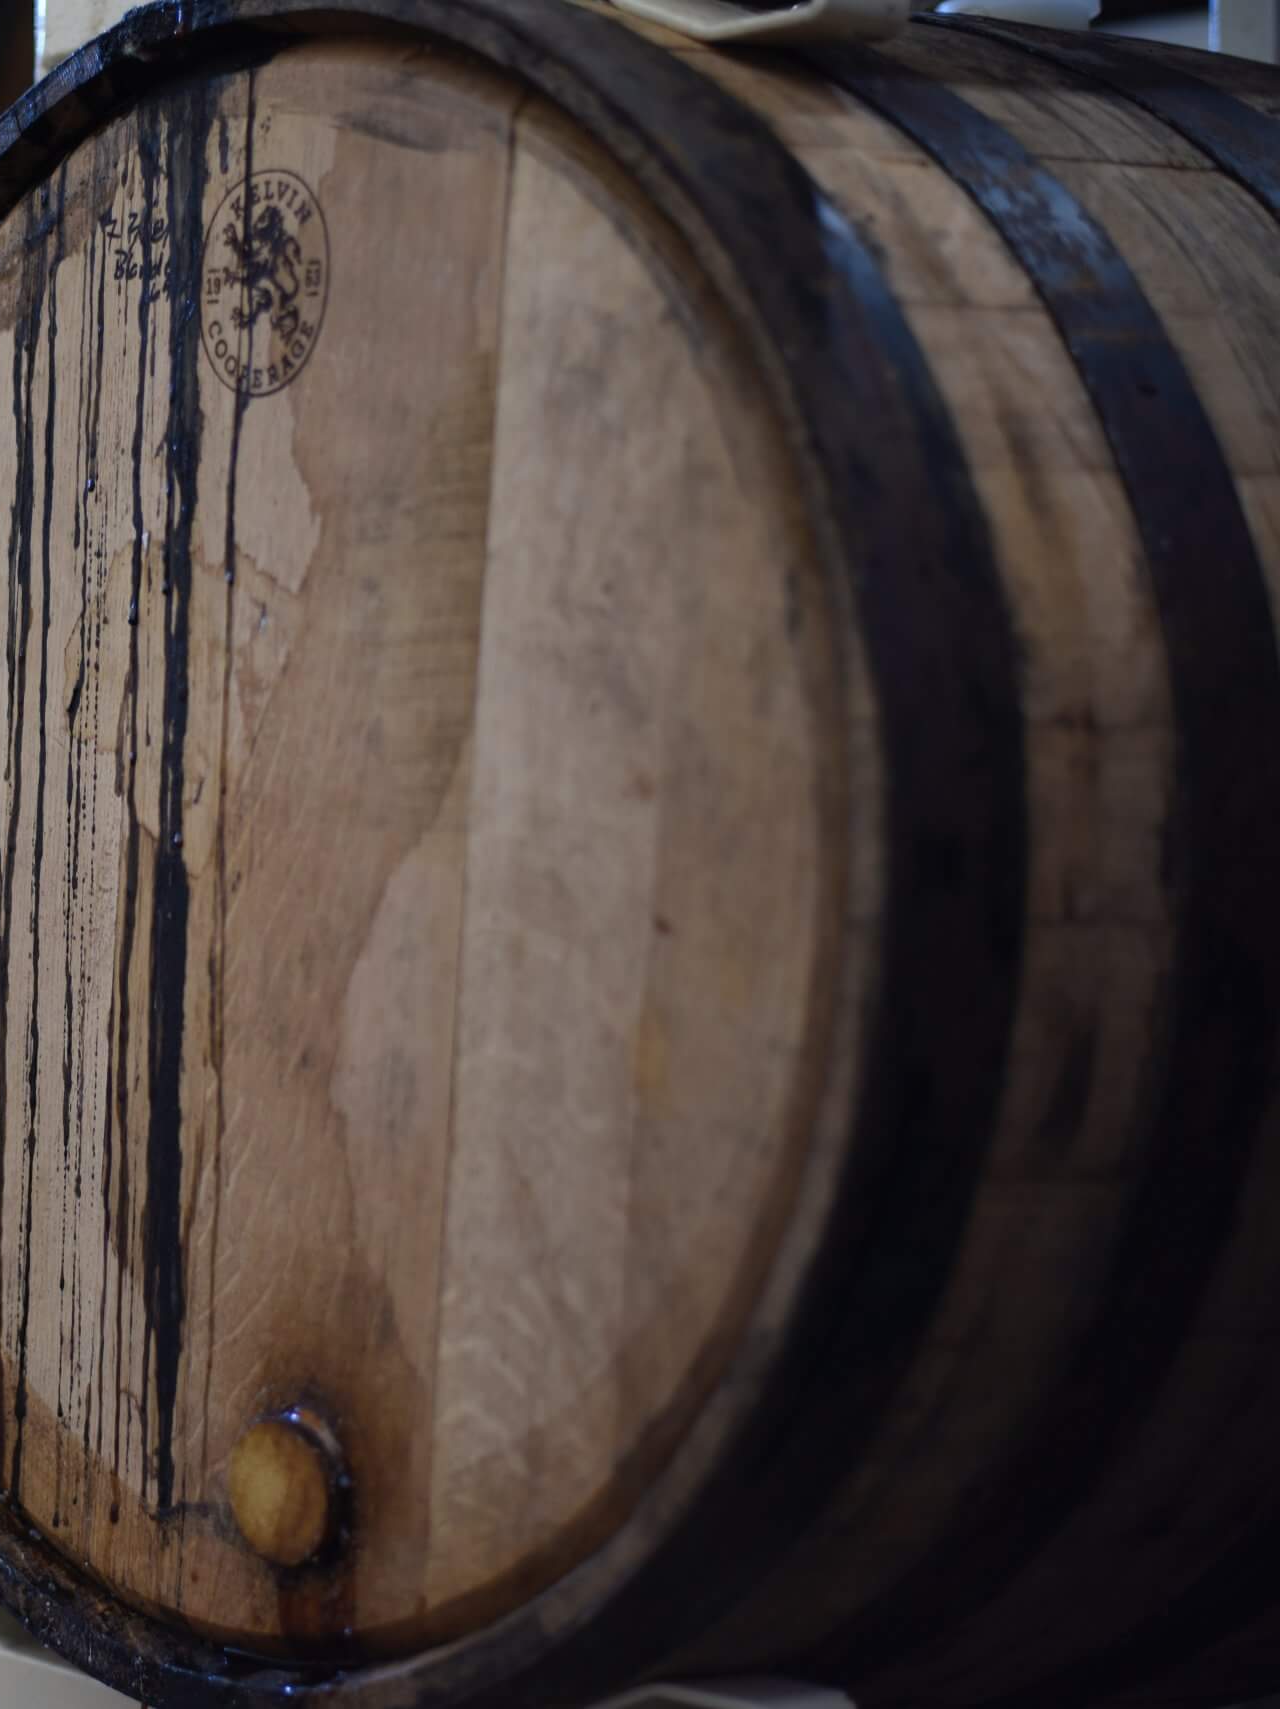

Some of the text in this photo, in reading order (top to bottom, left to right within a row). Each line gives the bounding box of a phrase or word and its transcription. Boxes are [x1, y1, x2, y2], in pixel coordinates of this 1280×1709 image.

[230, 180, 313, 224] KELVIN
[206, 277, 222, 296] 19
[207, 320, 315, 389] COOPERAGE
